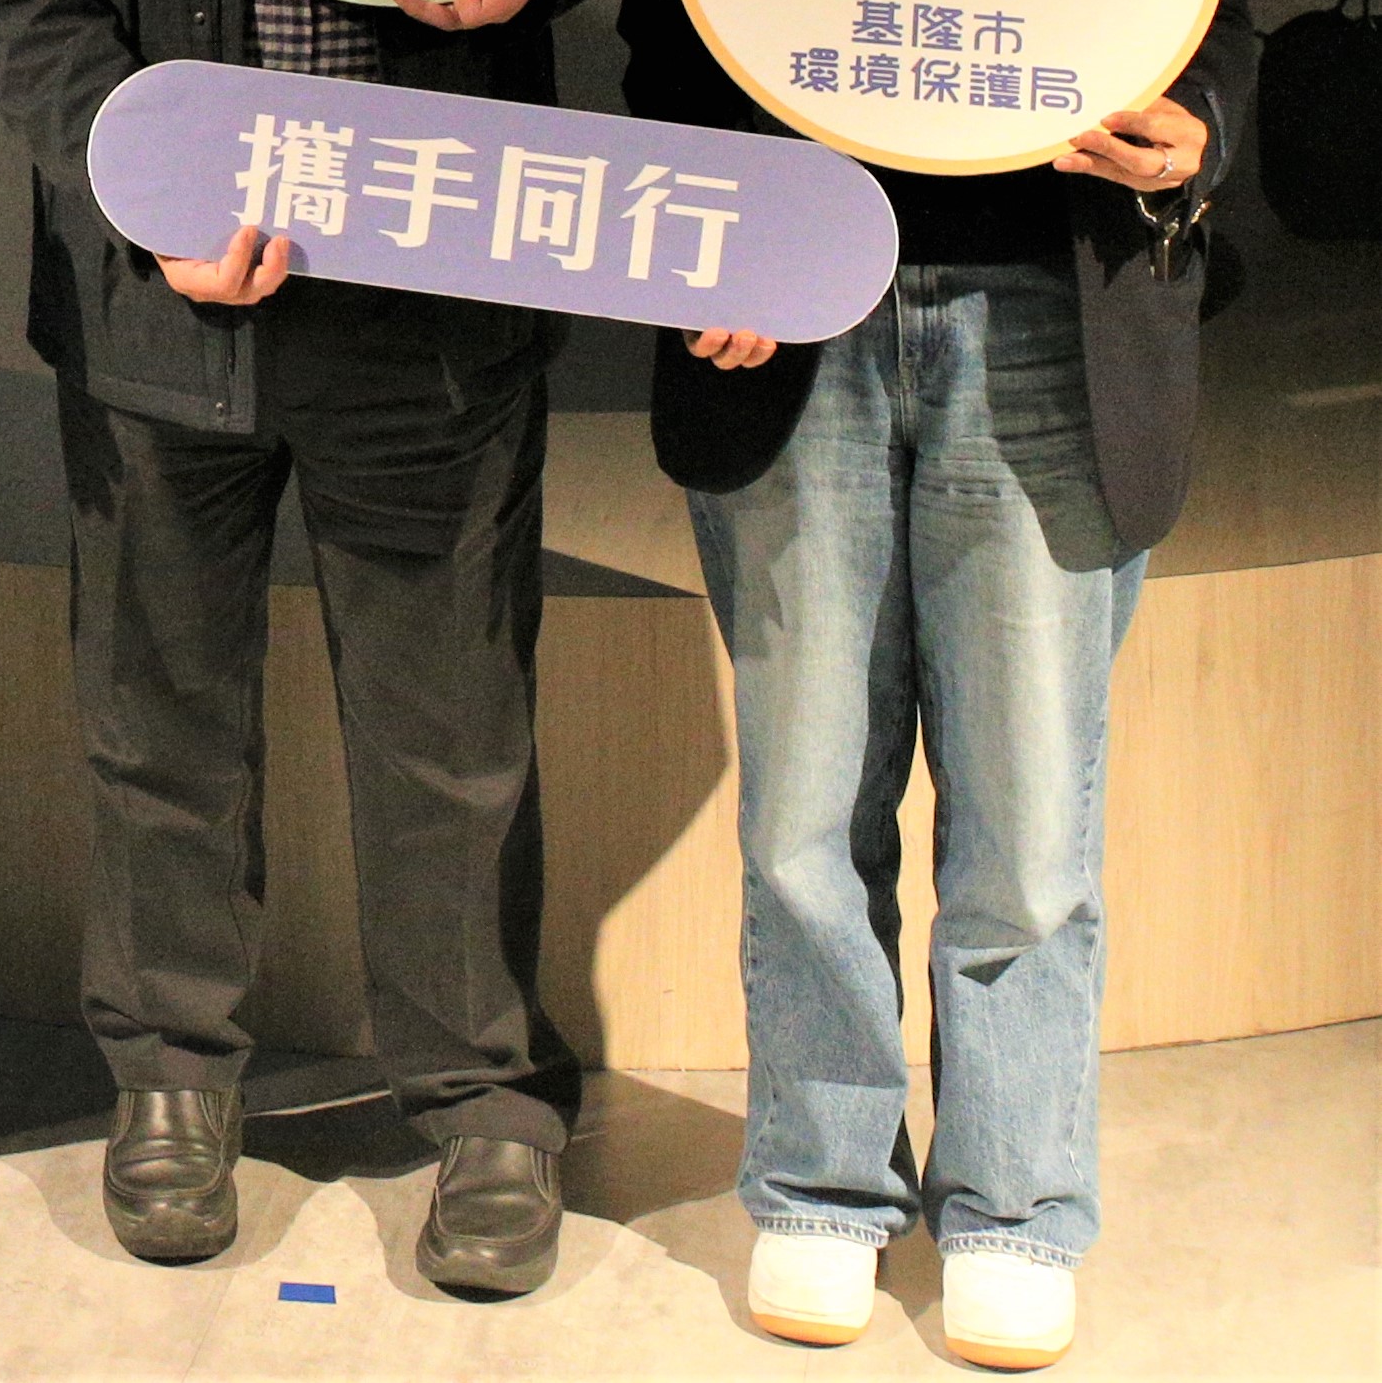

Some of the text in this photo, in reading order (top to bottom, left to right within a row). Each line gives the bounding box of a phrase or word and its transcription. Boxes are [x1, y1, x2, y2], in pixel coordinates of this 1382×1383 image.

[851, 0, 1025, 55] 基隆市
[789, 47, 1083, 115] 環境保護局
[231, 114, 740, 288] 攜手同行
